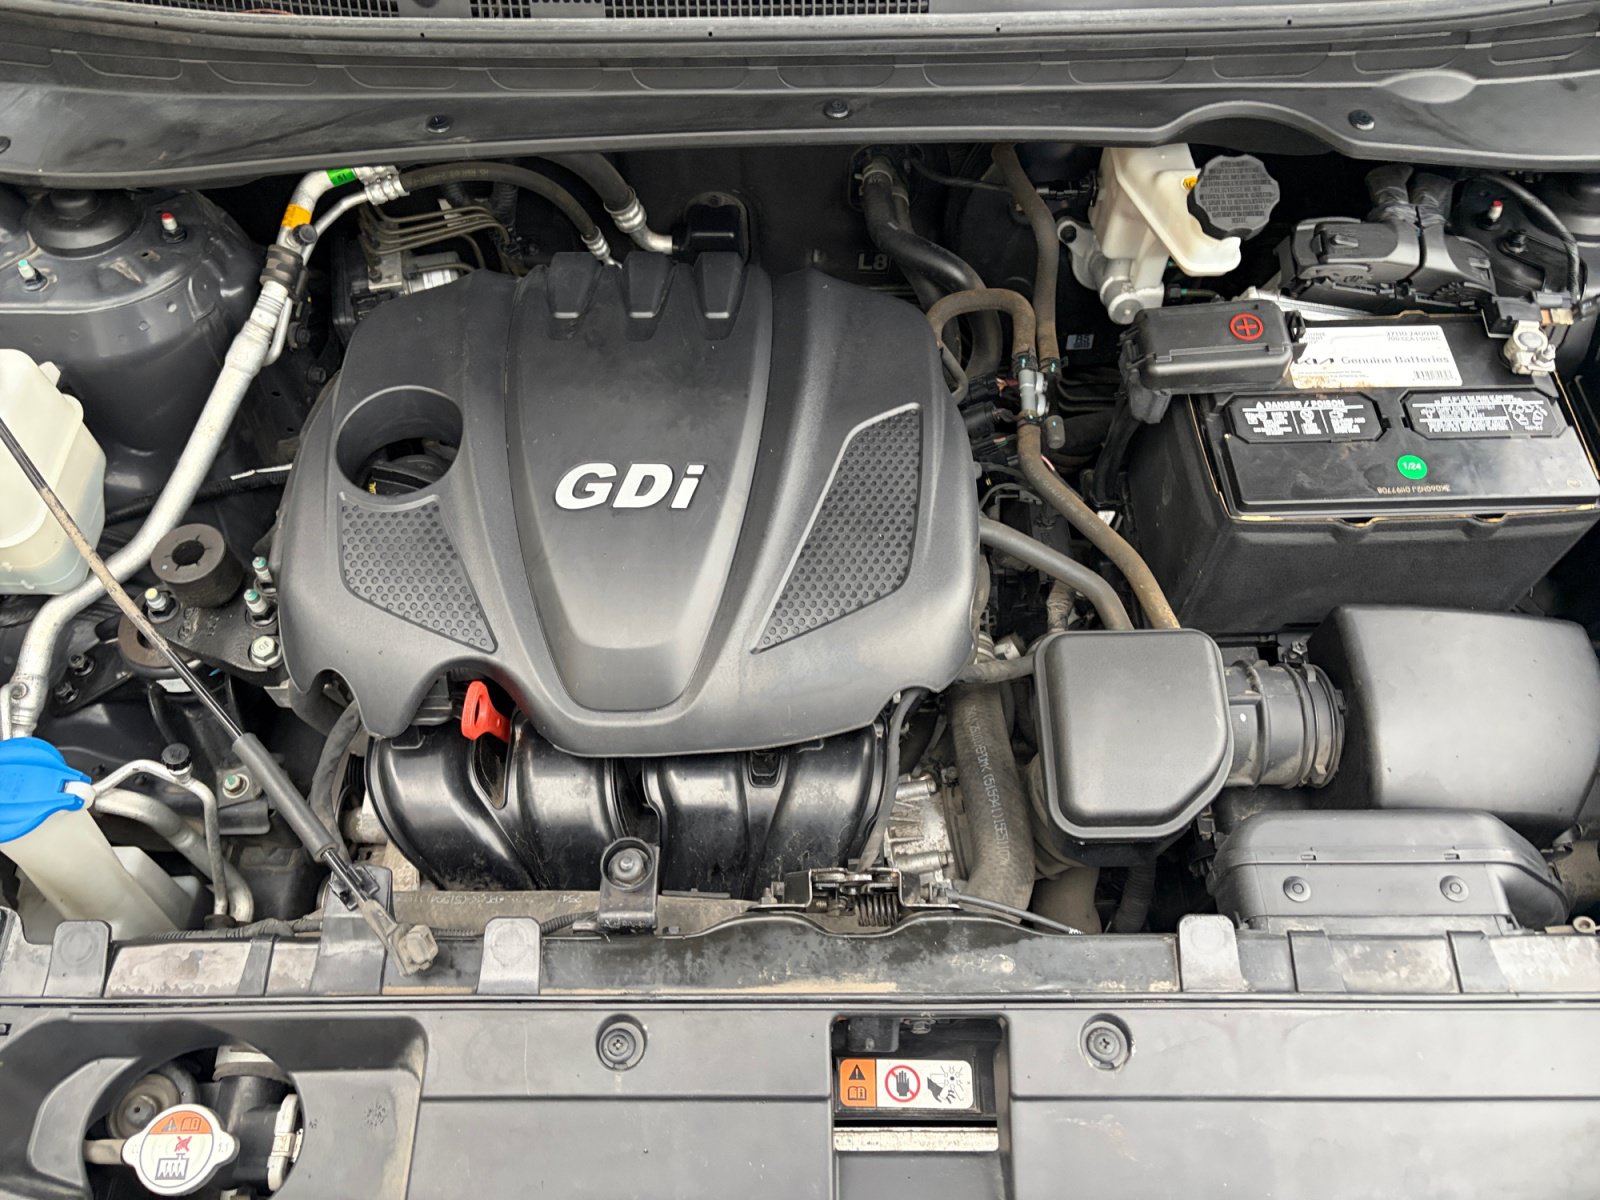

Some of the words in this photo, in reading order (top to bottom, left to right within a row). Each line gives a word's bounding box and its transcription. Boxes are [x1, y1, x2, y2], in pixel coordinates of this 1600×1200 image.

[858, 252, 888, 270] L8
[1341, 356, 1392, 365] Genuine
[1395, 355, 1450, 364] Batteries
[1264, 400, 1302, 410] DANGER
[1310, 398, 1346, 409] POISON
[1402, 462, 1422, 471] 1/24
[555, 462, 705, 510] GDi
